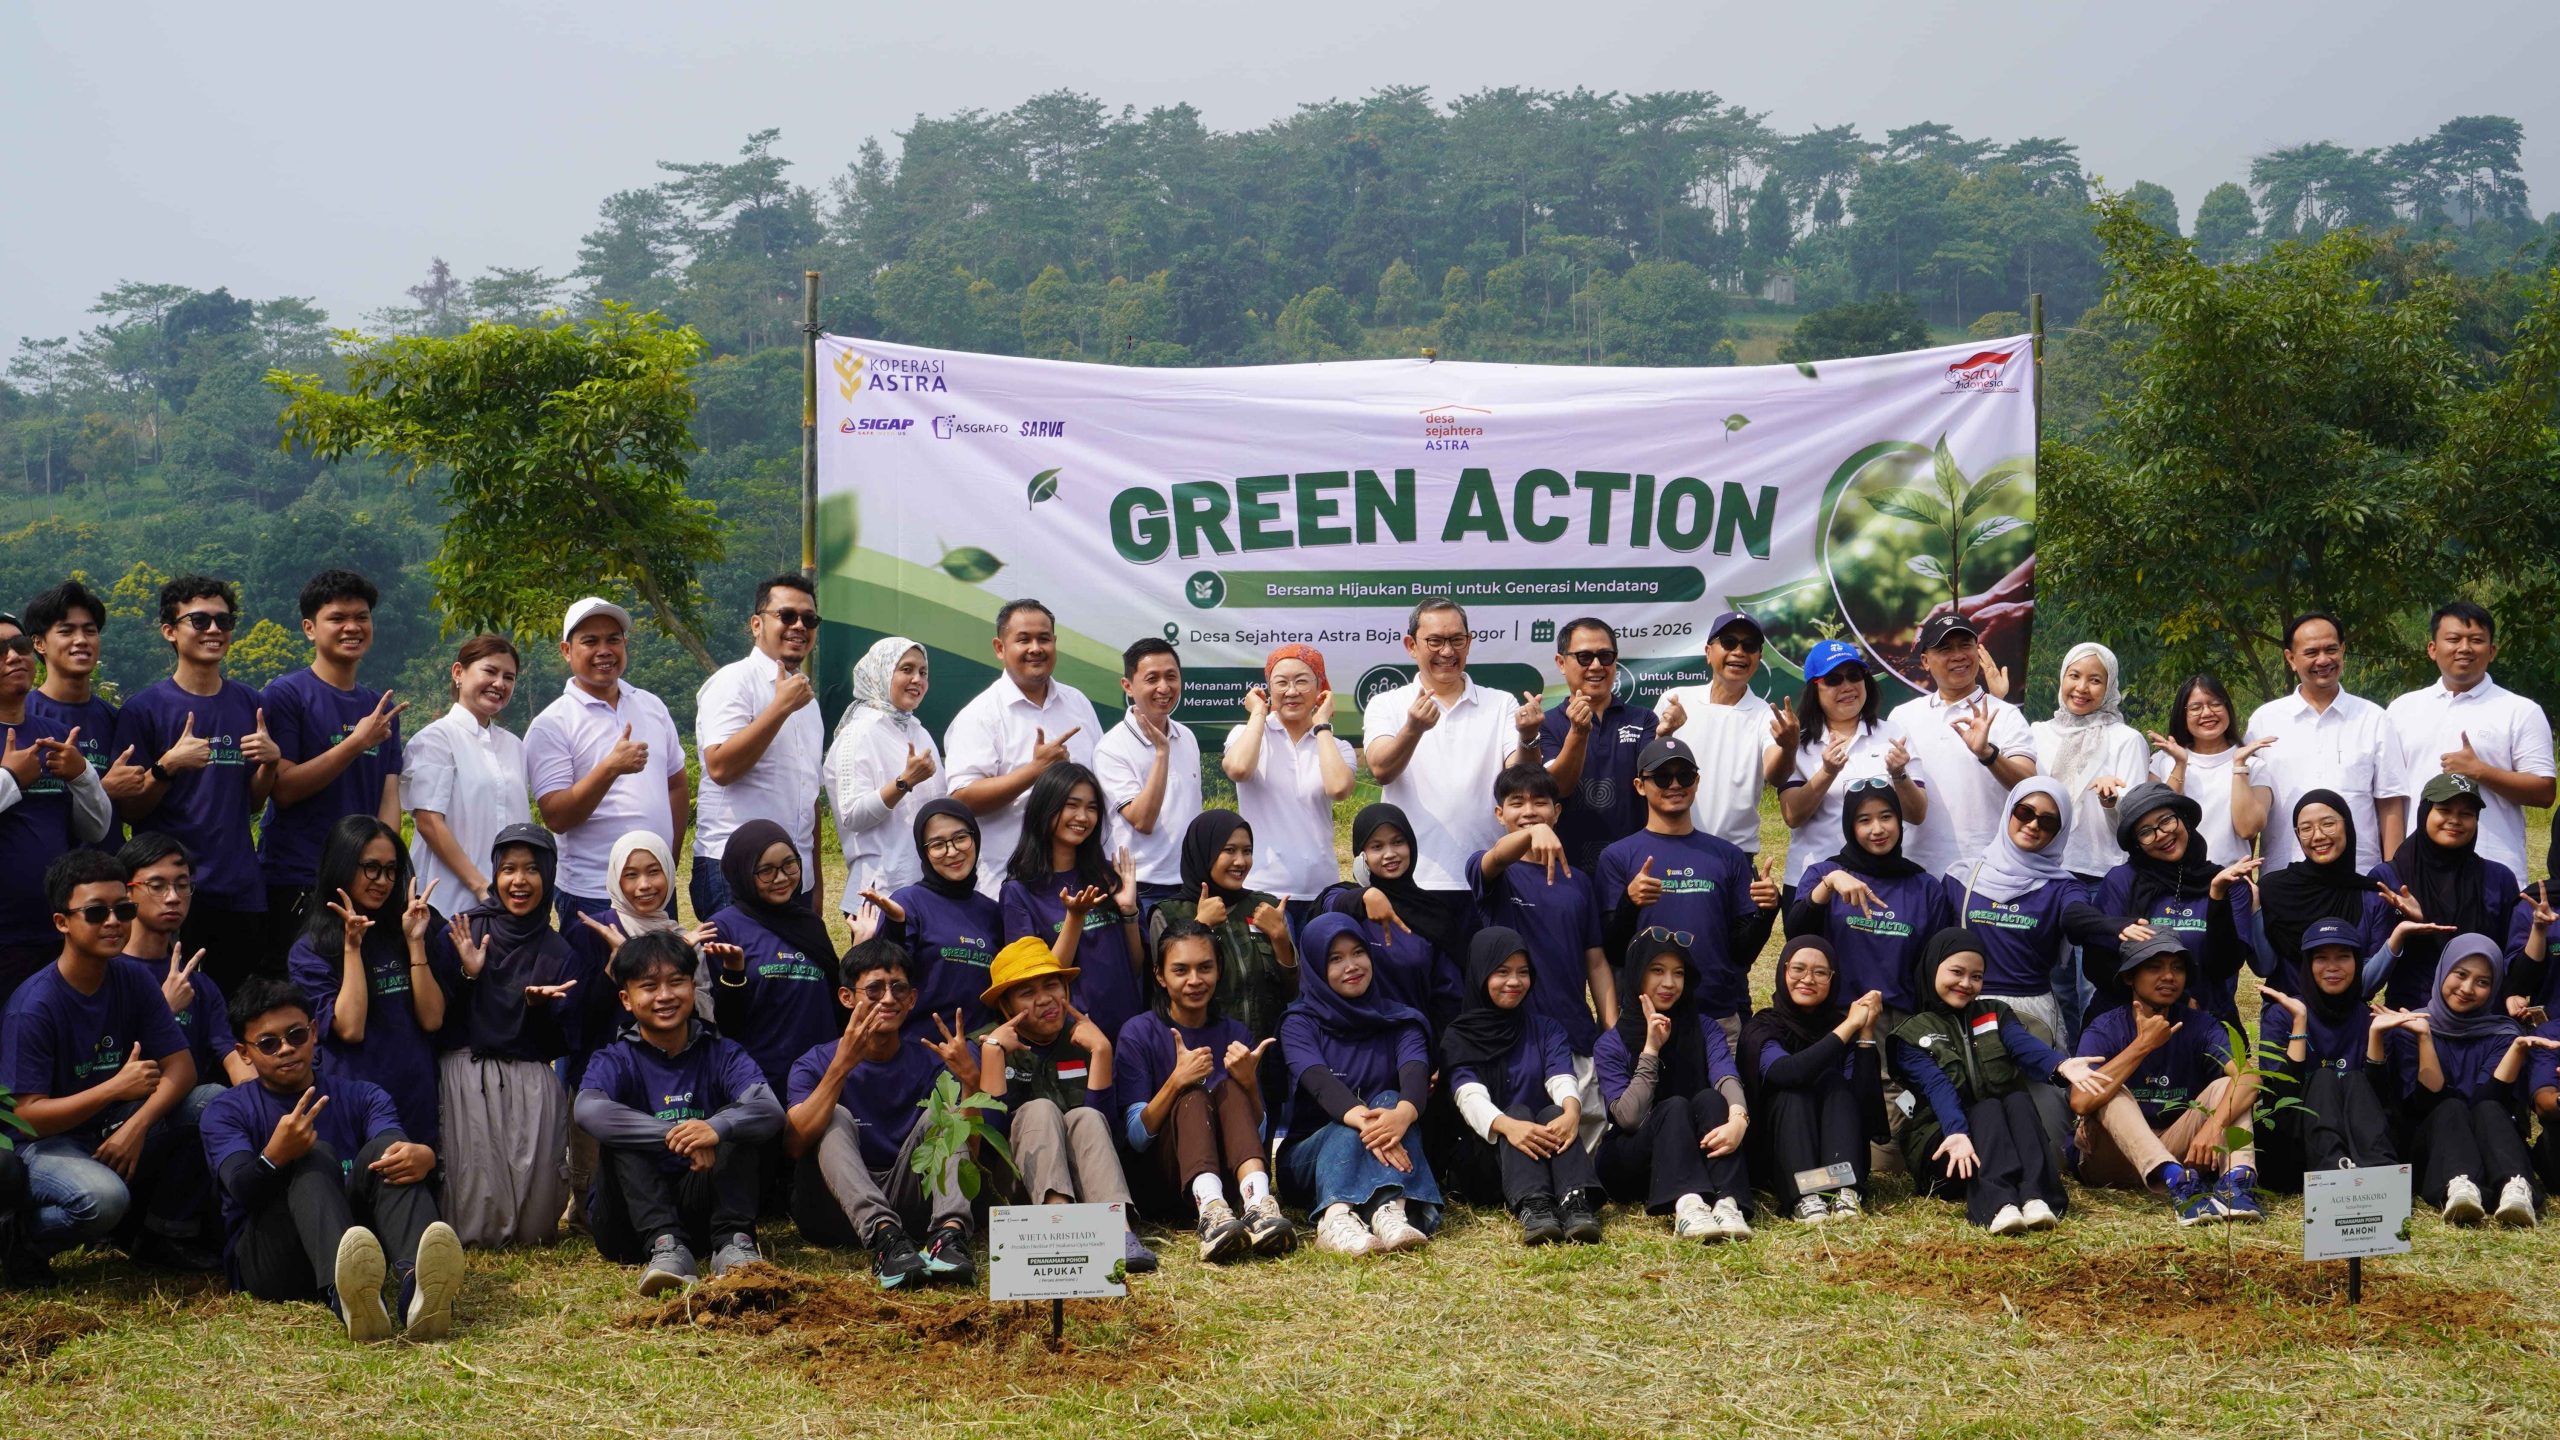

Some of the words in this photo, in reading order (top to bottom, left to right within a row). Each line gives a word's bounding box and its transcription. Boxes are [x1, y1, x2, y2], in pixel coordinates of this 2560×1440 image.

[870, 359, 945, 373] KOPERASI
[868, 374, 948, 393] ASTRA
[858, 418, 915, 430] SIGAP
[1426, 414, 1455, 424] desa
[955, 423, 1009, 434] ASGRAFO
[1425, 425, 1483, 438] sejahtera
[1425, 440, 1470, 451] ASTRA
[1109, 468, 1417, 565] GREEN
[1441, 468, 1779, 560] ACTION
[1266, 583, 1335, 596] Bersama
[1339, 583, 1407, 598] Hijaukan
[1411, 582, 1452, 595] Bumi
[1456, 581, 1501, 594] untuk
[1505, 580, 1571, 594] Generasi
[1574, 579, 1659, 594] Mendatang
[1614, 625, 1648, 638] stus
[1652, 622, 1692, 637] 2026
[1190, 630, 1230, 643] Desa
[1235, 629, 1313, 646] Sejahtera
[1318, 629, 1360, 642] Astra
[1366, 629, 1401, 645] Boja
[1470, 629, 1506, 643] ogor
[1639, 671, 1674, 681] Untuk
[1676, 671, 1709, 682] Bumi,
[1184, 682, 1242, 691] Menanam
[1639, 686, 1670, 696] Untu
[1184, 698, 1234, 707] Merawat
[1680, 879, 1715, 891] ACTION
[1968, 910, 2001, 921] GREEN
[2000, 913, 2038, 928] ACTION
[2177, 919, 2207, 928] ACTIO
[1846, 916, 1877, 928] GREEN
[1878, 921, 1914, 935] ACTION
[940, 947, 971, 959] GREEN
[758, 963, 791, 975] GREEN
[791, 965, 825, 979] ACTION
[2341, 1226, 2376, 1236] MAHONI
[1033, 1266, 1084, 1276] ALPUKAT
